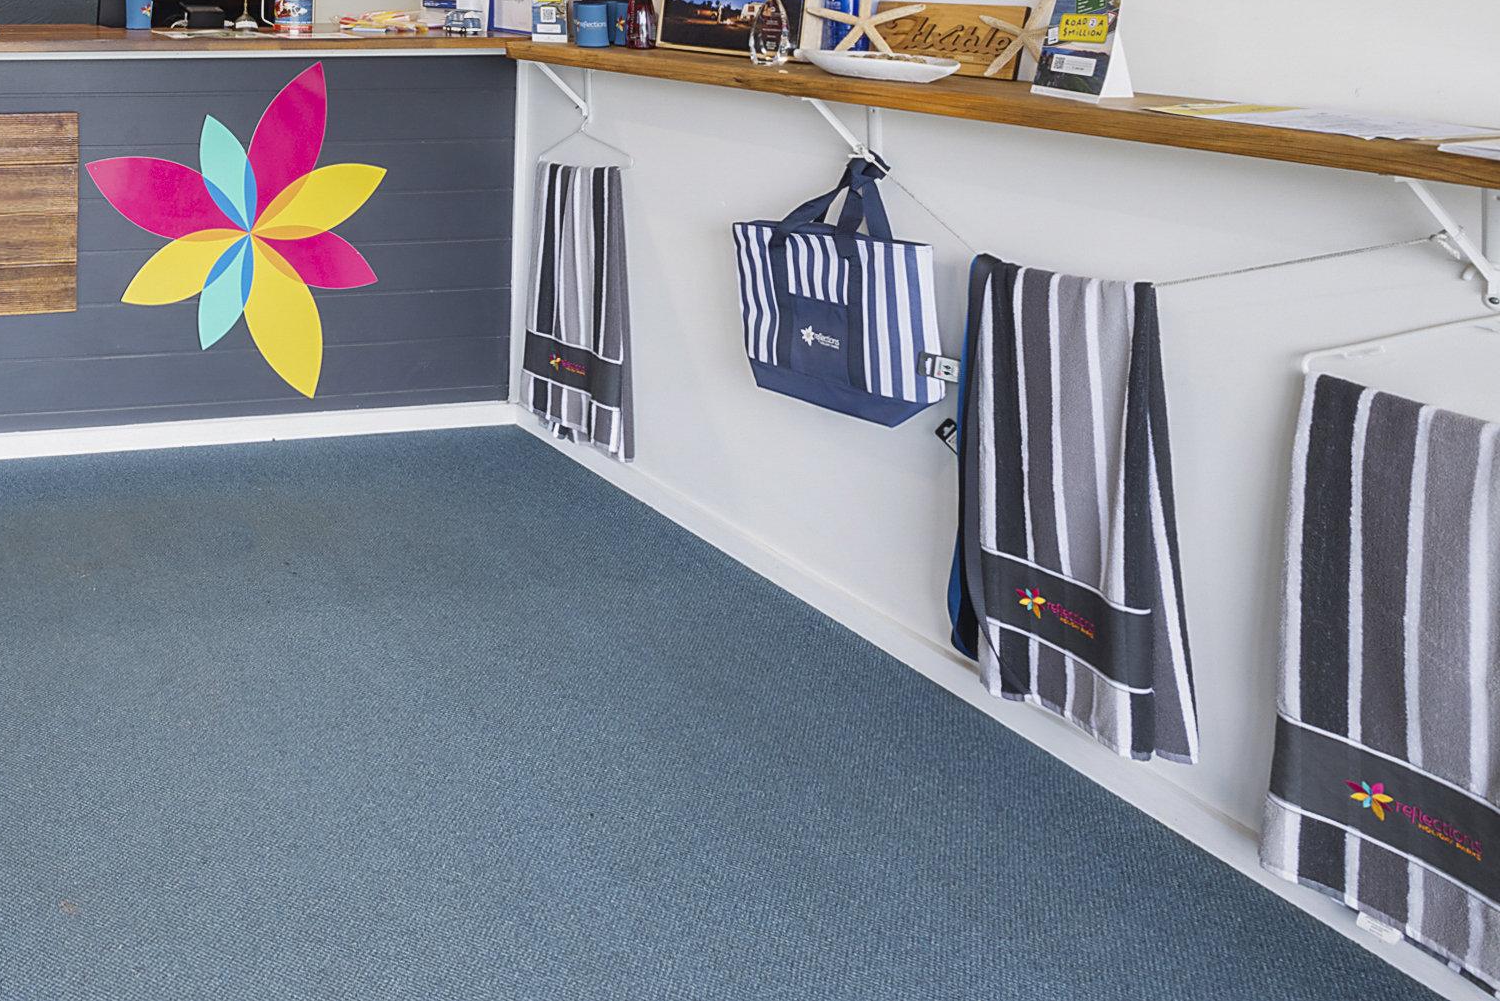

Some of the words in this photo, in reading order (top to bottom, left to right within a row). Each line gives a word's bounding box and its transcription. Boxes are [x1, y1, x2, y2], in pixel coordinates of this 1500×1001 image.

[1063, 29, 1103, 37] $MILLION
[1065, 18, 1087, 26] ROAD
[1394, 801, 1483, 854] reflections
[1418, 823, 1453, 844] HOLIDAY
[1455, 842, 1482, 862] PARKS
